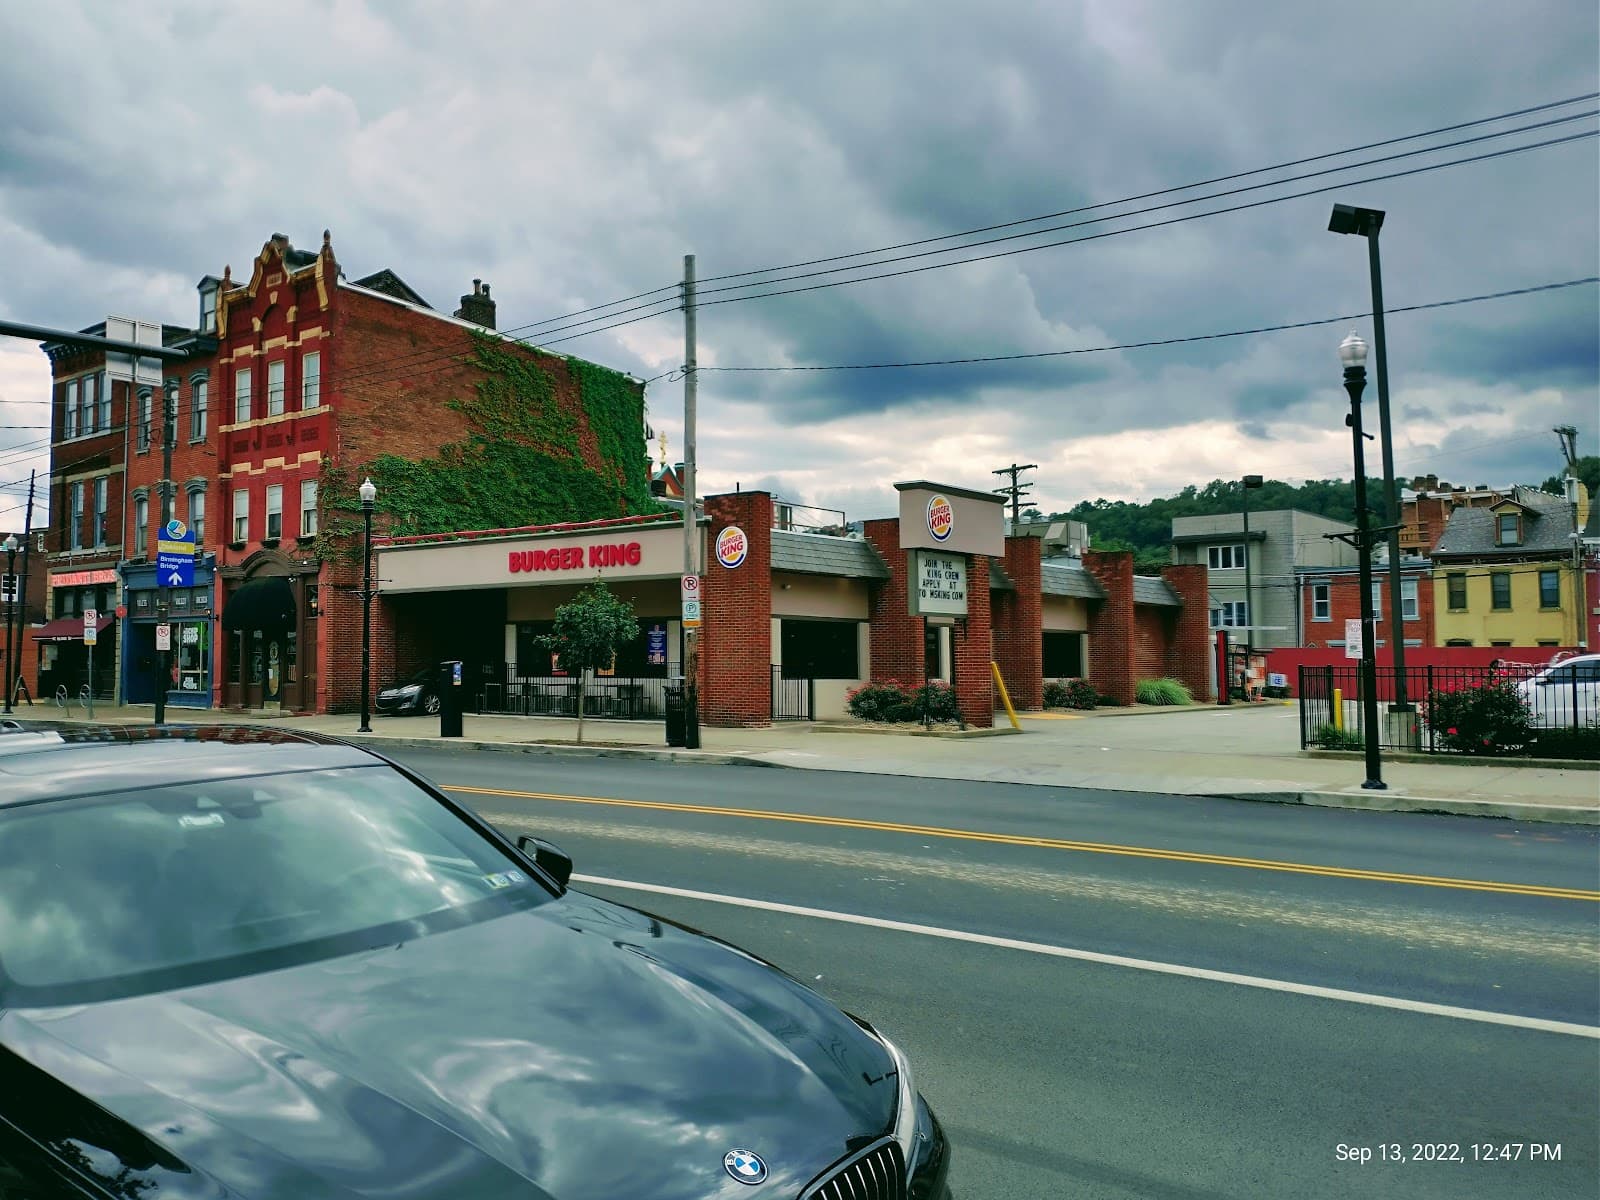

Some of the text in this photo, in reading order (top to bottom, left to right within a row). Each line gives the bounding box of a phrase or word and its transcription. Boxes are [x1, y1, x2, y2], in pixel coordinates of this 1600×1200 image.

[930, 505, 950, 518] BURGER
[931, 513, 951, 529] KING
[720, 534, 743, 549] BURGER
[720, 541, 743, 558] KING
[160, 556, 193, 565] Birmingham
[509, 542, 641, 573] BURGER KING
[160, 562, 179, 571] Bridge
[924, 559, 953, 570] JOIN THE
[927, 569, 942, 579] KING
[922, 579, 957, 590] APPLY AT
